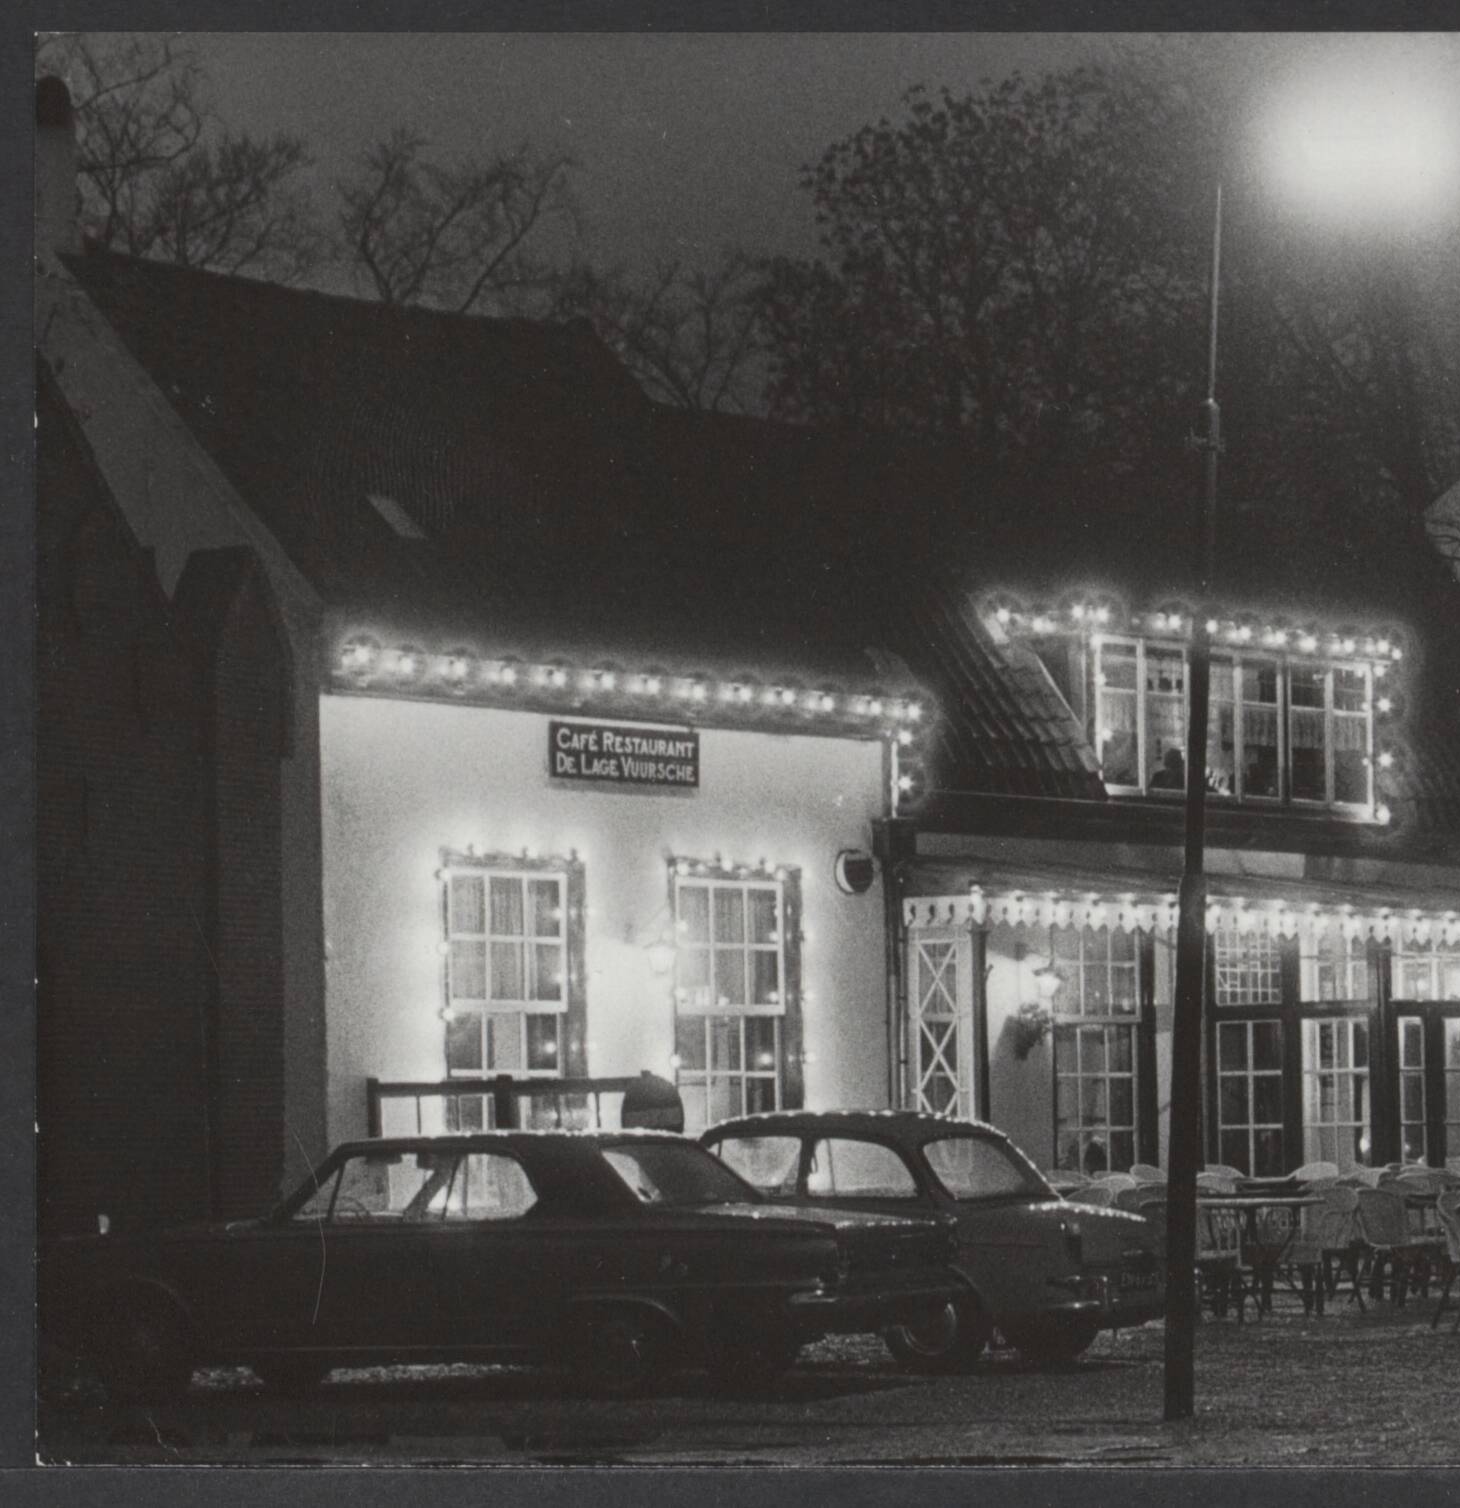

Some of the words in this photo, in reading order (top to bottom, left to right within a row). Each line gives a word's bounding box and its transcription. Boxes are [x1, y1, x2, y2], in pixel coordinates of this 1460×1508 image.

[556, 727, 599, 752] CAFÉ
[602, 731, 695, 758] RESTAURANT
[555, 751, 577, 775] DE
[580, 753, 620, 777] LAGE
[620, 755, 695, 782] VUURSCHE
